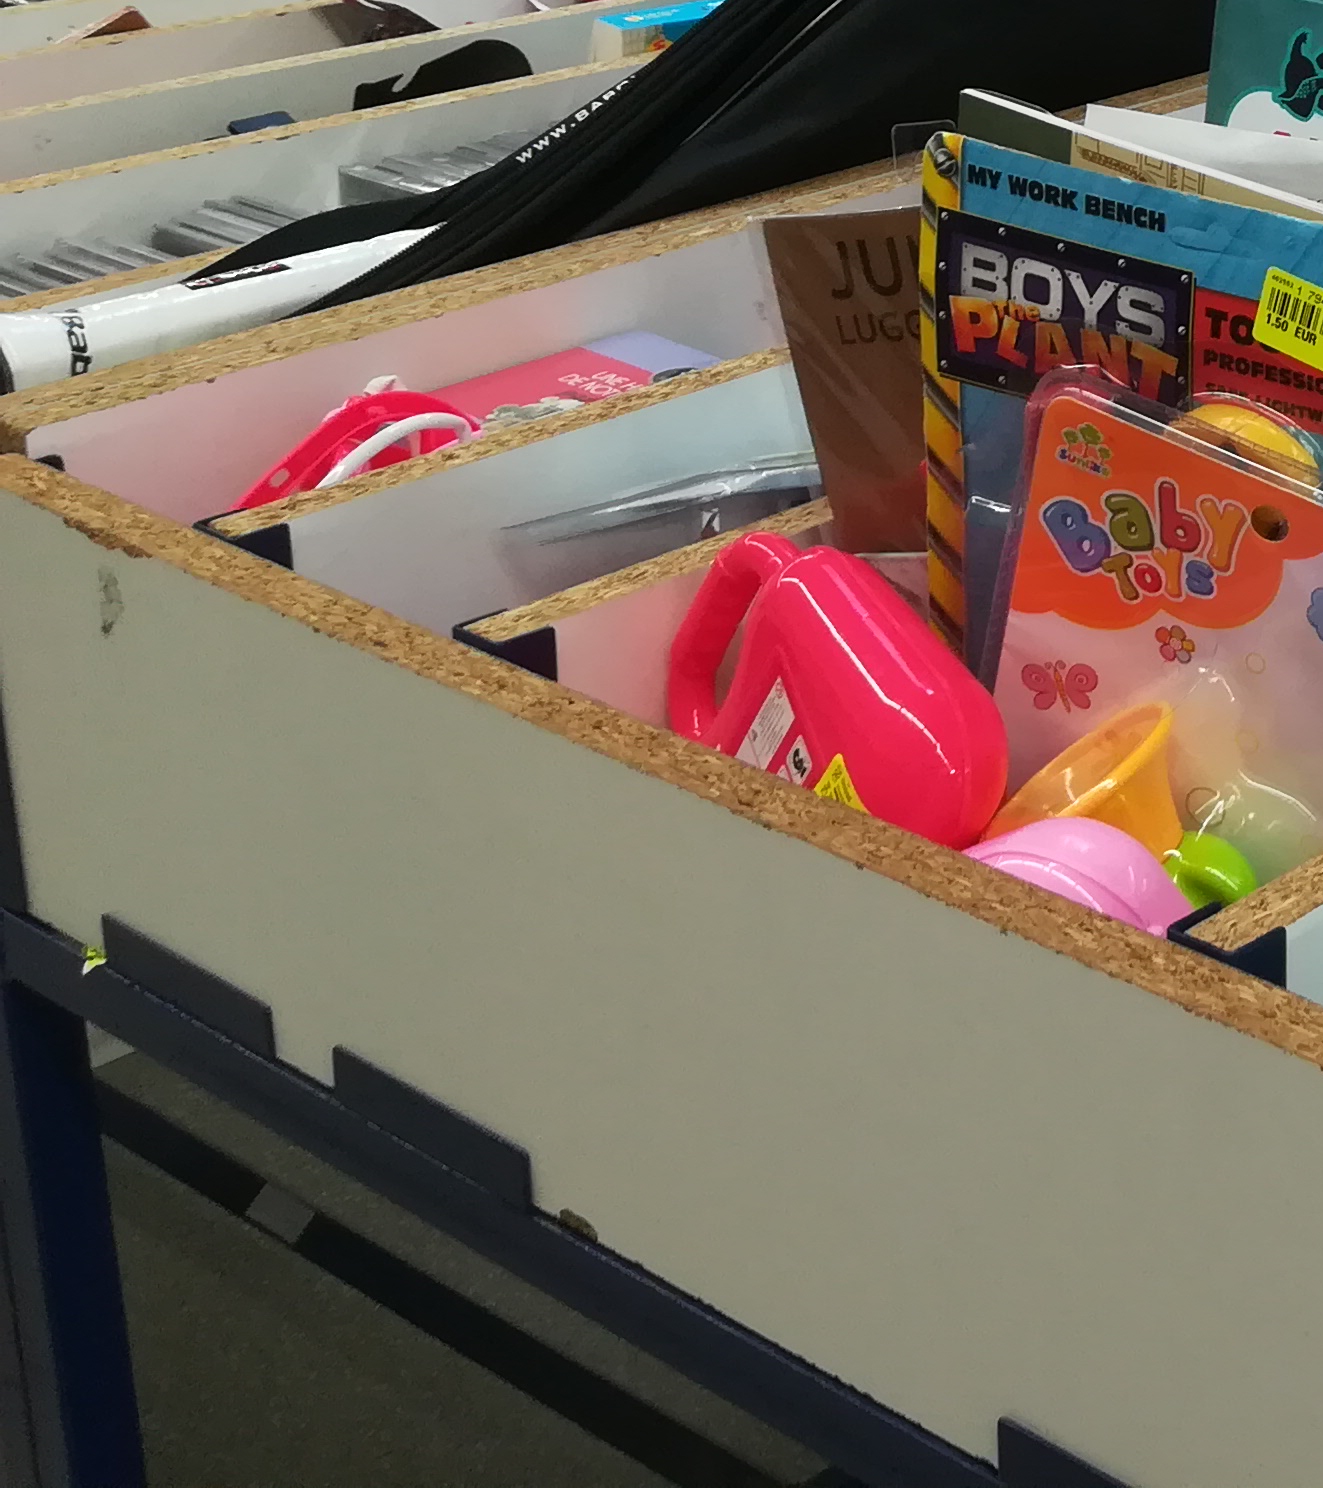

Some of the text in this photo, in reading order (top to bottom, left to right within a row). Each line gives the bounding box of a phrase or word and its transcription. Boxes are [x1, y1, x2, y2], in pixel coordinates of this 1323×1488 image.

[968, 164, 1166, 233] MY WORK BENCH
[831, 235, 919, 300] JU
[961, 242, 1166, 347] BOYS
[949, 295, 1178, 411] PLANT
[1266, 313, 1317, 345] 1.50 EUR
[1041, 478, 1249, 575] Baby
